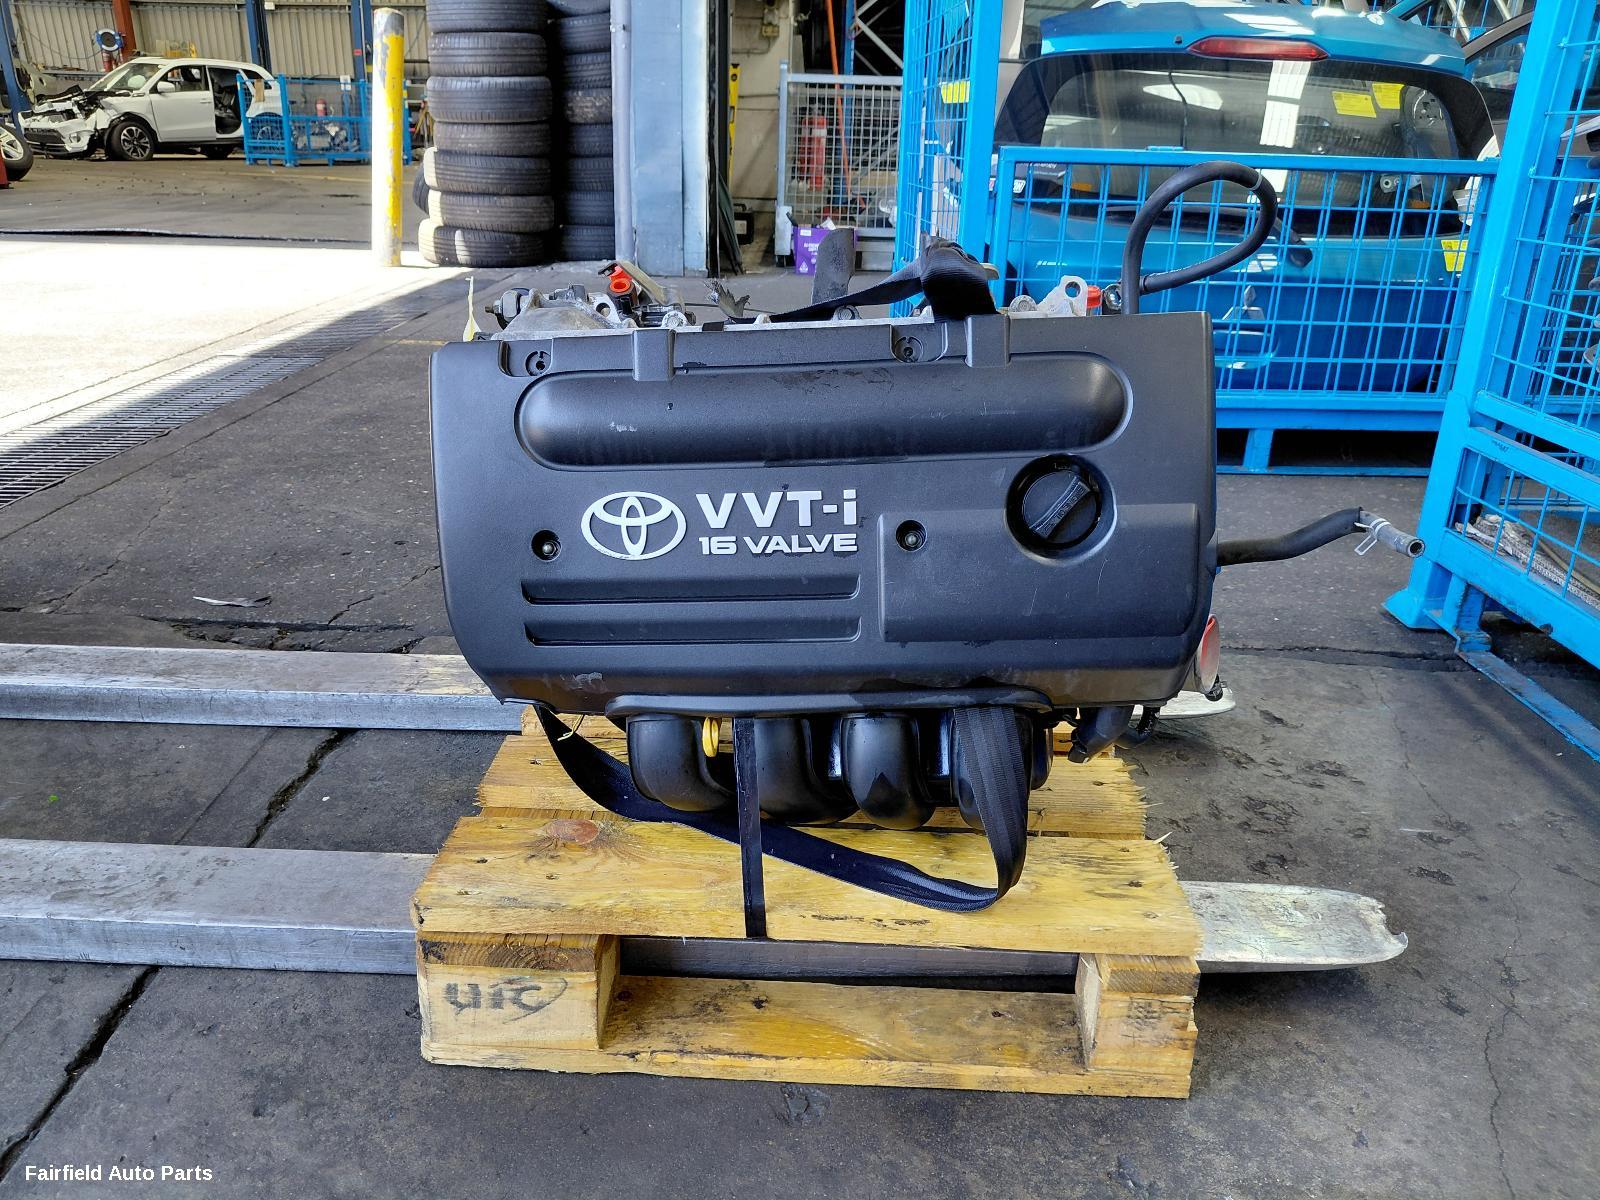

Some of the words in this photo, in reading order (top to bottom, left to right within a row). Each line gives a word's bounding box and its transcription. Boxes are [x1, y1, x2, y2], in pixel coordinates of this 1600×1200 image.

[695, 489, 857, 529] VVT-i
[699, 535, 737, 555] 16
[743, 533, 858, 554] VALVE
